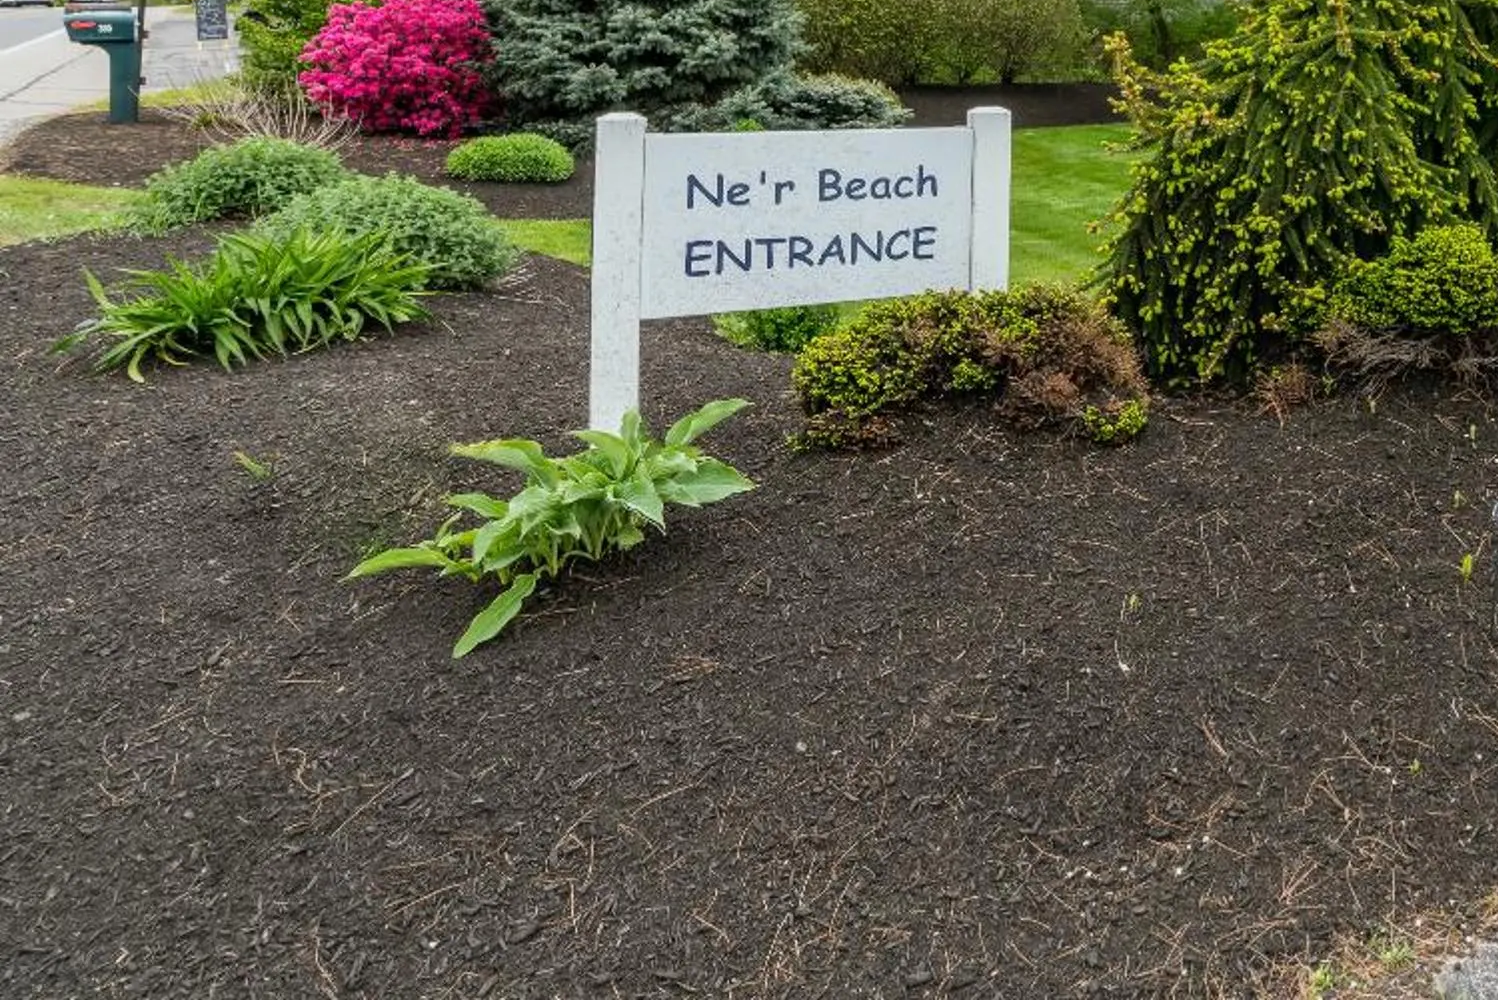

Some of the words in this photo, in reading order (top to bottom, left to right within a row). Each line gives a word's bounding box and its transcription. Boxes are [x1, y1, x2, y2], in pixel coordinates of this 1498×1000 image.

[687, 170, 795, 210] Ne'r
[818, 164, 938, 202] Beach
[684, 226, 937, 278] ENTRANCE
